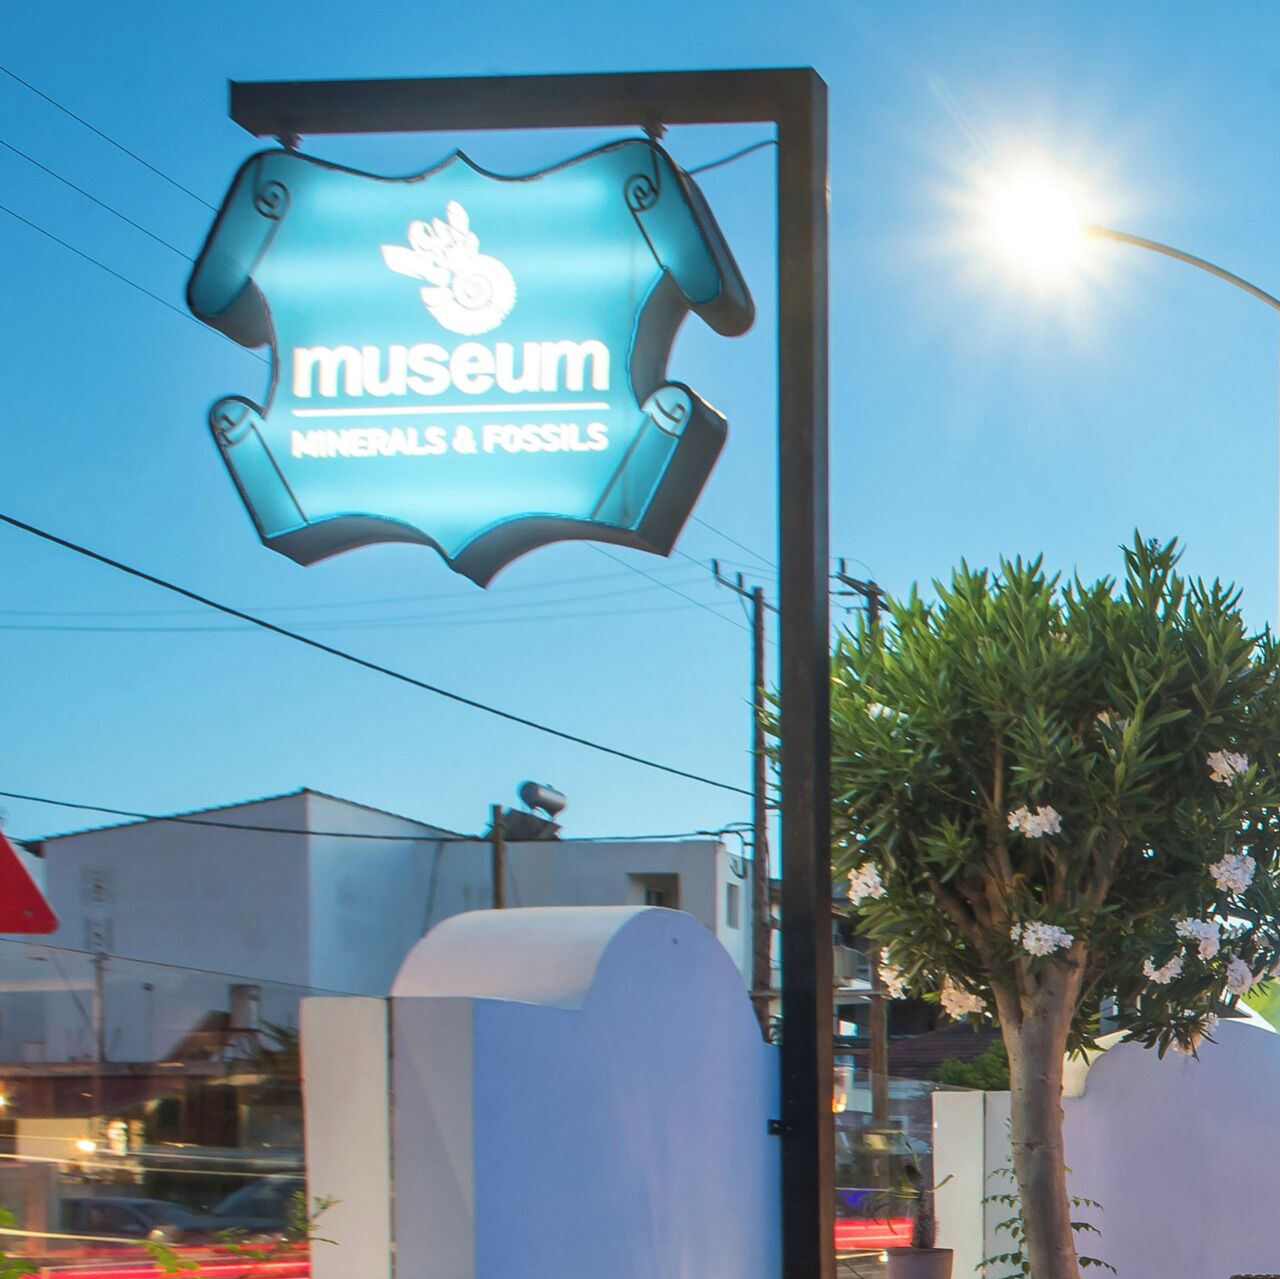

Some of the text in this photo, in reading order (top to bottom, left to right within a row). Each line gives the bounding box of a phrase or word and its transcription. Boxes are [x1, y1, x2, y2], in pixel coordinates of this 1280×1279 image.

[292, 340, 610, 398] museum
[291, 422, 609, 458] MINERALS & FOSSILS
